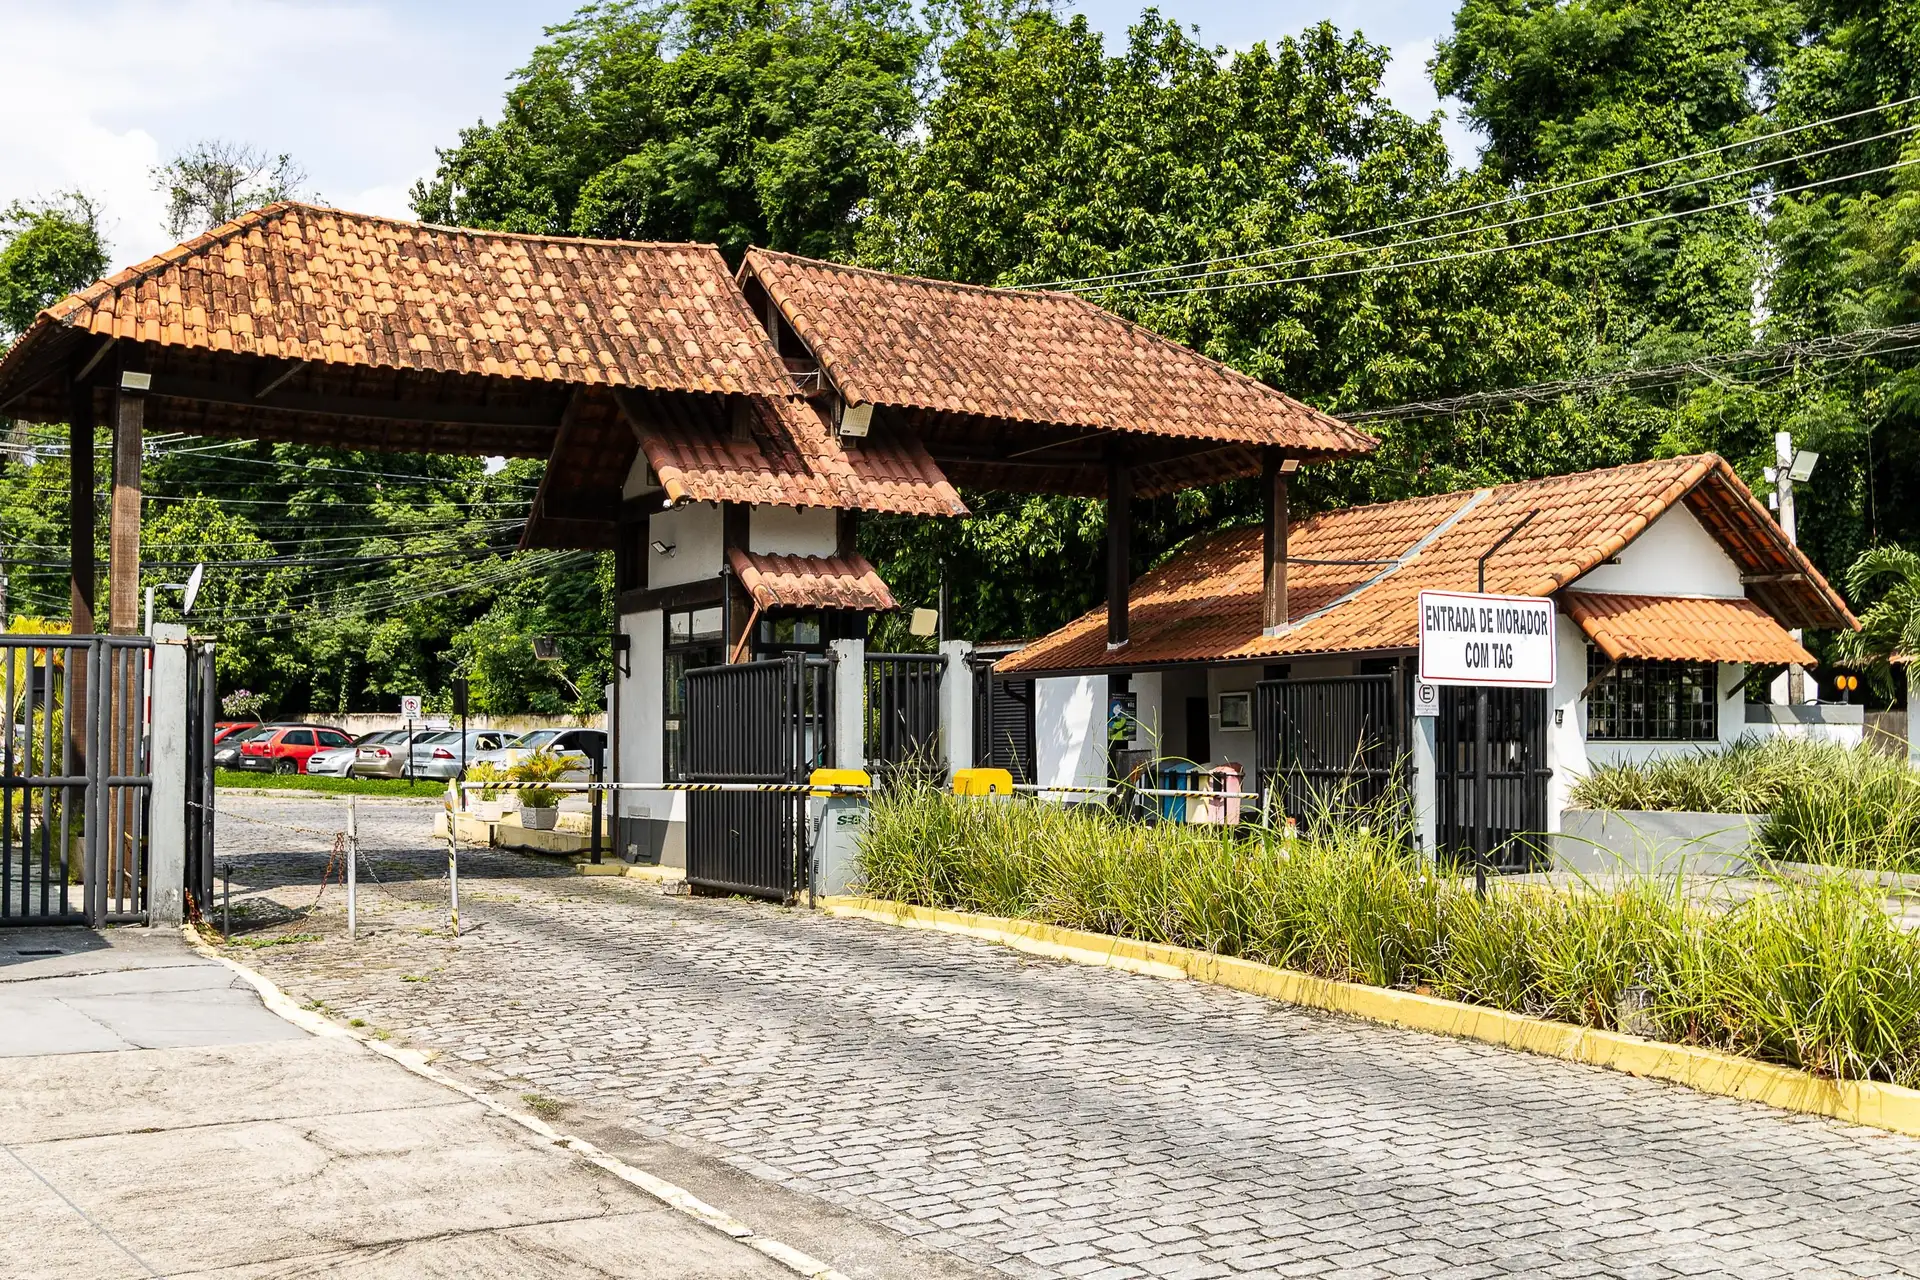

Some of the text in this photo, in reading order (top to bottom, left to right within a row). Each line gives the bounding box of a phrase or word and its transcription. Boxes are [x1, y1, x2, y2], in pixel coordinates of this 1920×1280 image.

[1425, 605, 1548, 636] ENTRADA DE MORADOR
[1465, 642, 1513, 669] COM TAG
